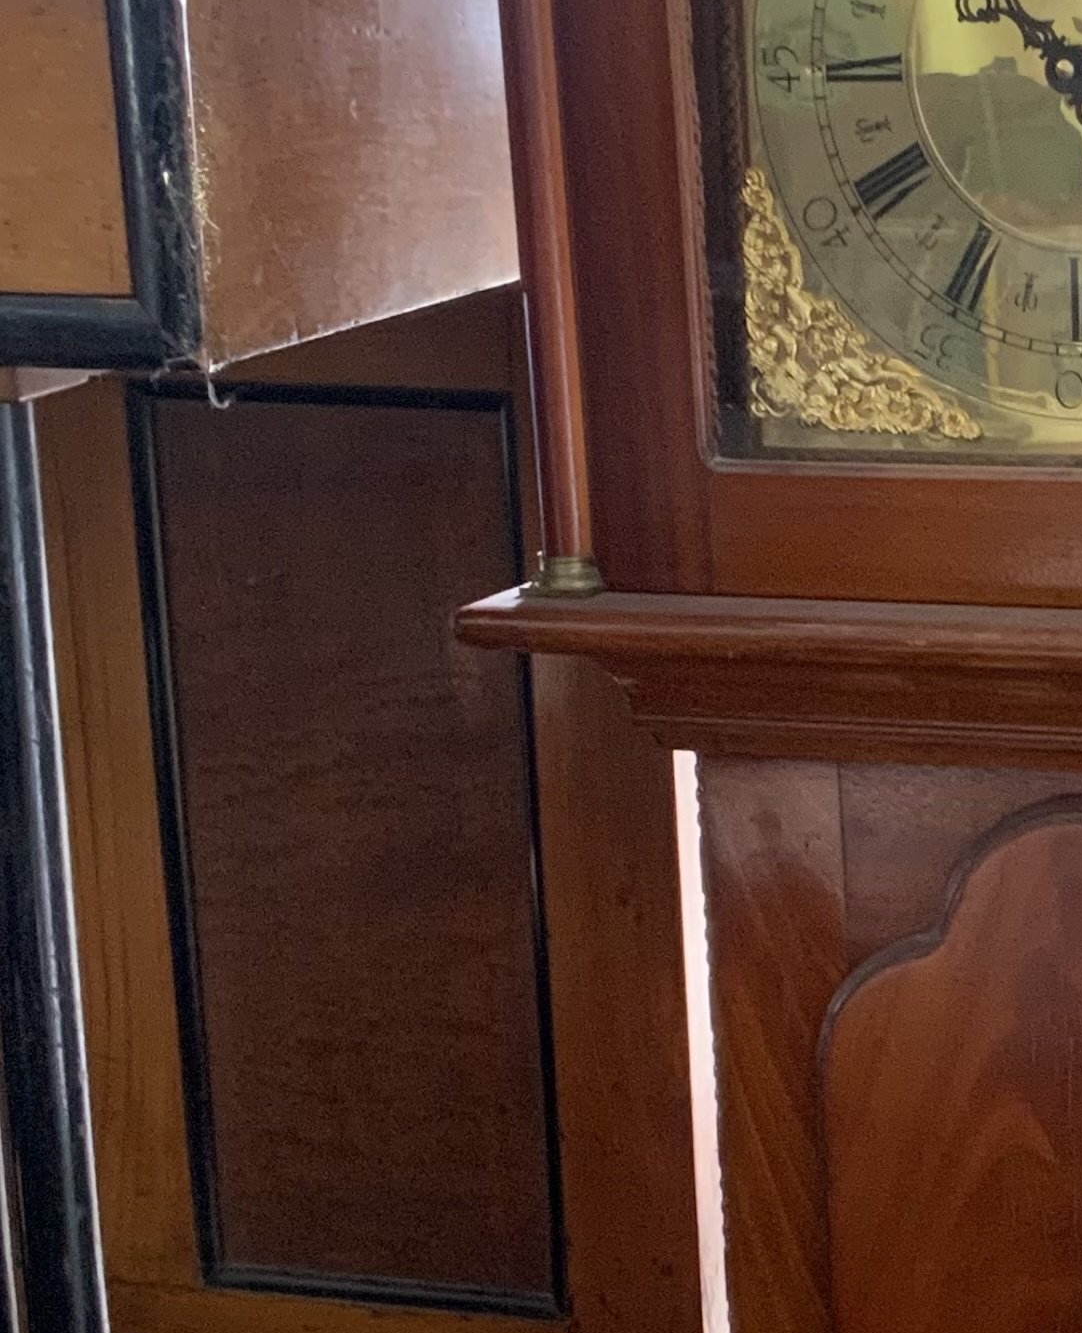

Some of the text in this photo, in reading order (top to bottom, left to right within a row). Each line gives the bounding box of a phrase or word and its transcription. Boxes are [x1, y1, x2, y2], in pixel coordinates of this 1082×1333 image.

[762, 45, 800, 93] 45
[803, 197, 849, 246] 40
[914, 323, 965, 373] 35
